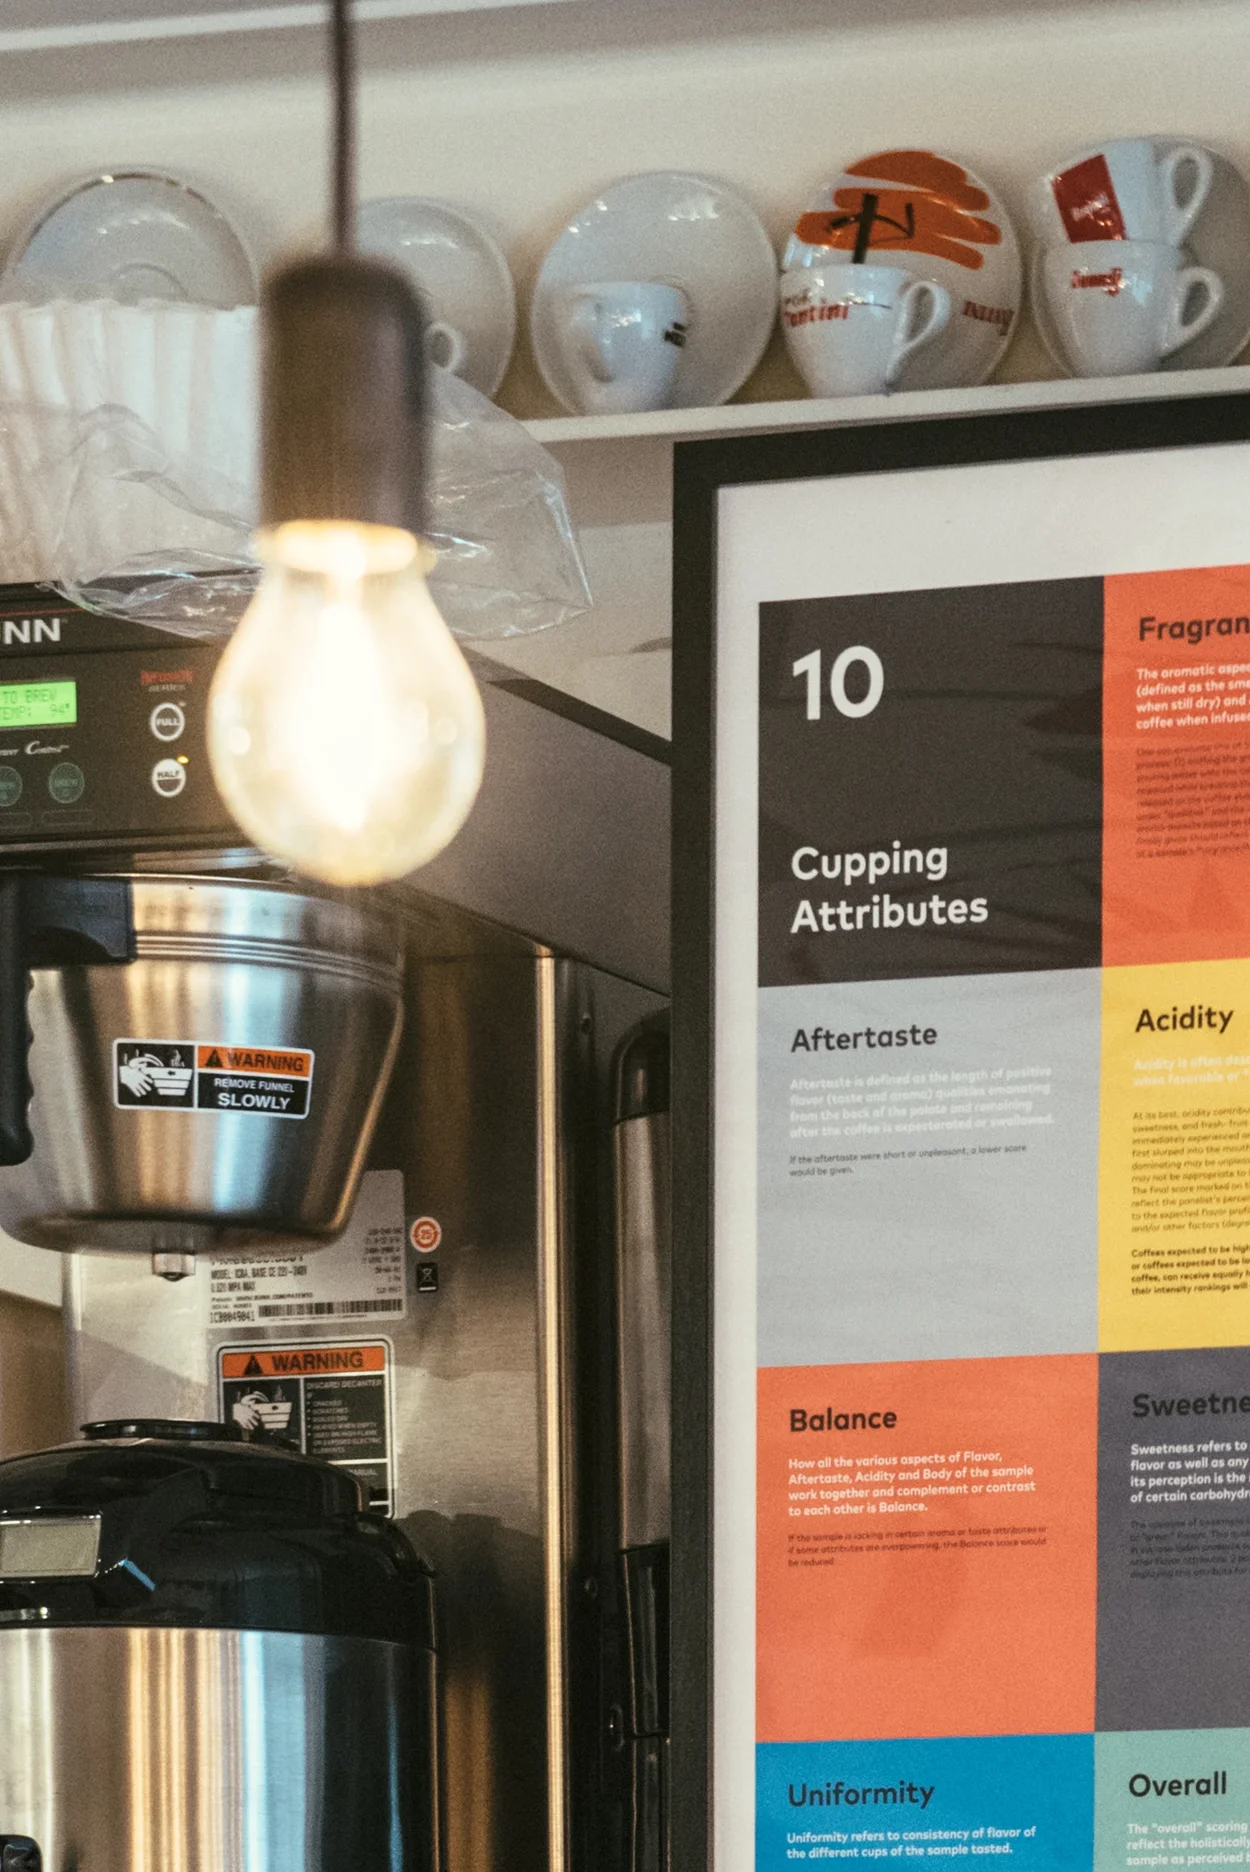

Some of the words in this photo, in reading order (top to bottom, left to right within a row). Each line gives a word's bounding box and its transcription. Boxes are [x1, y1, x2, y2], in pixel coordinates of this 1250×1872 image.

[0, 618, 61, 645] NN
[791, 644, 884, 721] 10
[25, 688, 57, 703] BREW
[0, 706, 31, 721] EMP:
[157, 716, 179, 727] FULL
[157, 770, 180, 780] HALF
[791, 840, 948, 885] Cupping
[791, 892, 989, 934] Attributes
[1135, 1005, 1234, 1034] Acidity
[791, 1024, 938, 1053] Aftertaste
[230, 1051, 304, 1072] WARNING
[214, 1077, 256, 1090] REMOVE
[258, 1081, 295, 1093] FUNNEL
[218, 1092, 290, 1110] SLOWLY
[272, 1351, 364, 1371] WARNING
[307, 1381, 340, 1390] DISCARD
[342, 1379, 382, 1389] DECANTER
[790, 1407, 898, 1432] Balance
[1130, 1442, 1194, 1456] Sweetness
[1196, 1441, 1232, 1453] refers
[1234, 1440, 1247, 1452] to
[788, 1458, 815, 1470] How
[817, 1457, 832, 1469] all
[833, 1456, 853, 1468] the
[855, 1455, 898, 1467] various
[900, 1453, 945, 1469] aspects
[948, 1453, 960, 1464] of
[963, 1451, 1002, 1465] Flavor,
[1130, 1459, 1164, 1471] flavor
[1167, 1461, 1182, 1470] as
[1184, 1457, 1208, 1469] well
[1210, 1459, 1225, 1468] as
[1227, 1458, 1248, 1471] any
[788, 1472, 852, 1487] Aftertaste,
[855, 1471, 895, 1486] Acidity
[898, 1470, 920, 1481] and
[922, 1469, 952, 1484] Body
[954, 1468, 966, 1479] of
[970, 1467, 989, 1479] the
[991, 1466, 1033, 1481] sample
[1130, 1475, 1146, 1487] its
[1148, 1473, 1211, 1489] perception
[1213, 1472, 1223, 1484] is
[1226, 1472, 1246, 1483] the
[788, 1489, 817, 1501] work
[819, 1487, 869, 1503] together
[872, 1486, 894, 1498] and
[896, 1483, 968, 1500] complement
[970, 1485, 982, 1494] or
[985, 1481, 1035, 1493] contrast
[1130, 1492, 1142, 1503] of
[1145, 1490, 1187, 1502] certain
[788, 1505, 801, 1517] to
[803, 1504, 831, 1516] each
[832, 1503, 863, 1515] other
[866, 1503, 876, 1514] is
[878, 1501, 927, 1513] Balance.
[1129, 1771, 1227, 1797] Overall
[789, 1780, 935, 1809] Uniformity
[786, 1832, 848, 1847] Uniformity
[850, 1831, 885, 1842] refers
[886, 1830, 900, 1841] to
[902, 1828, 969, 1844] consistency
[971, 1828, 984, 1839] of
[986, 1827, 1020, 1838] flavor
[1022, 1826, 1036, 1837] of
[786, 1848, 806, 1859] the
[808, 1846, 859, 1858] different
[860, 1848, 888, 1860] cups
[890, 1845, 902, 1857] of
[904, 1845, 924, 1856] the
[926, 1844, 968, 1859] sample
[970, 1843, 1012, 1855] tasted.
